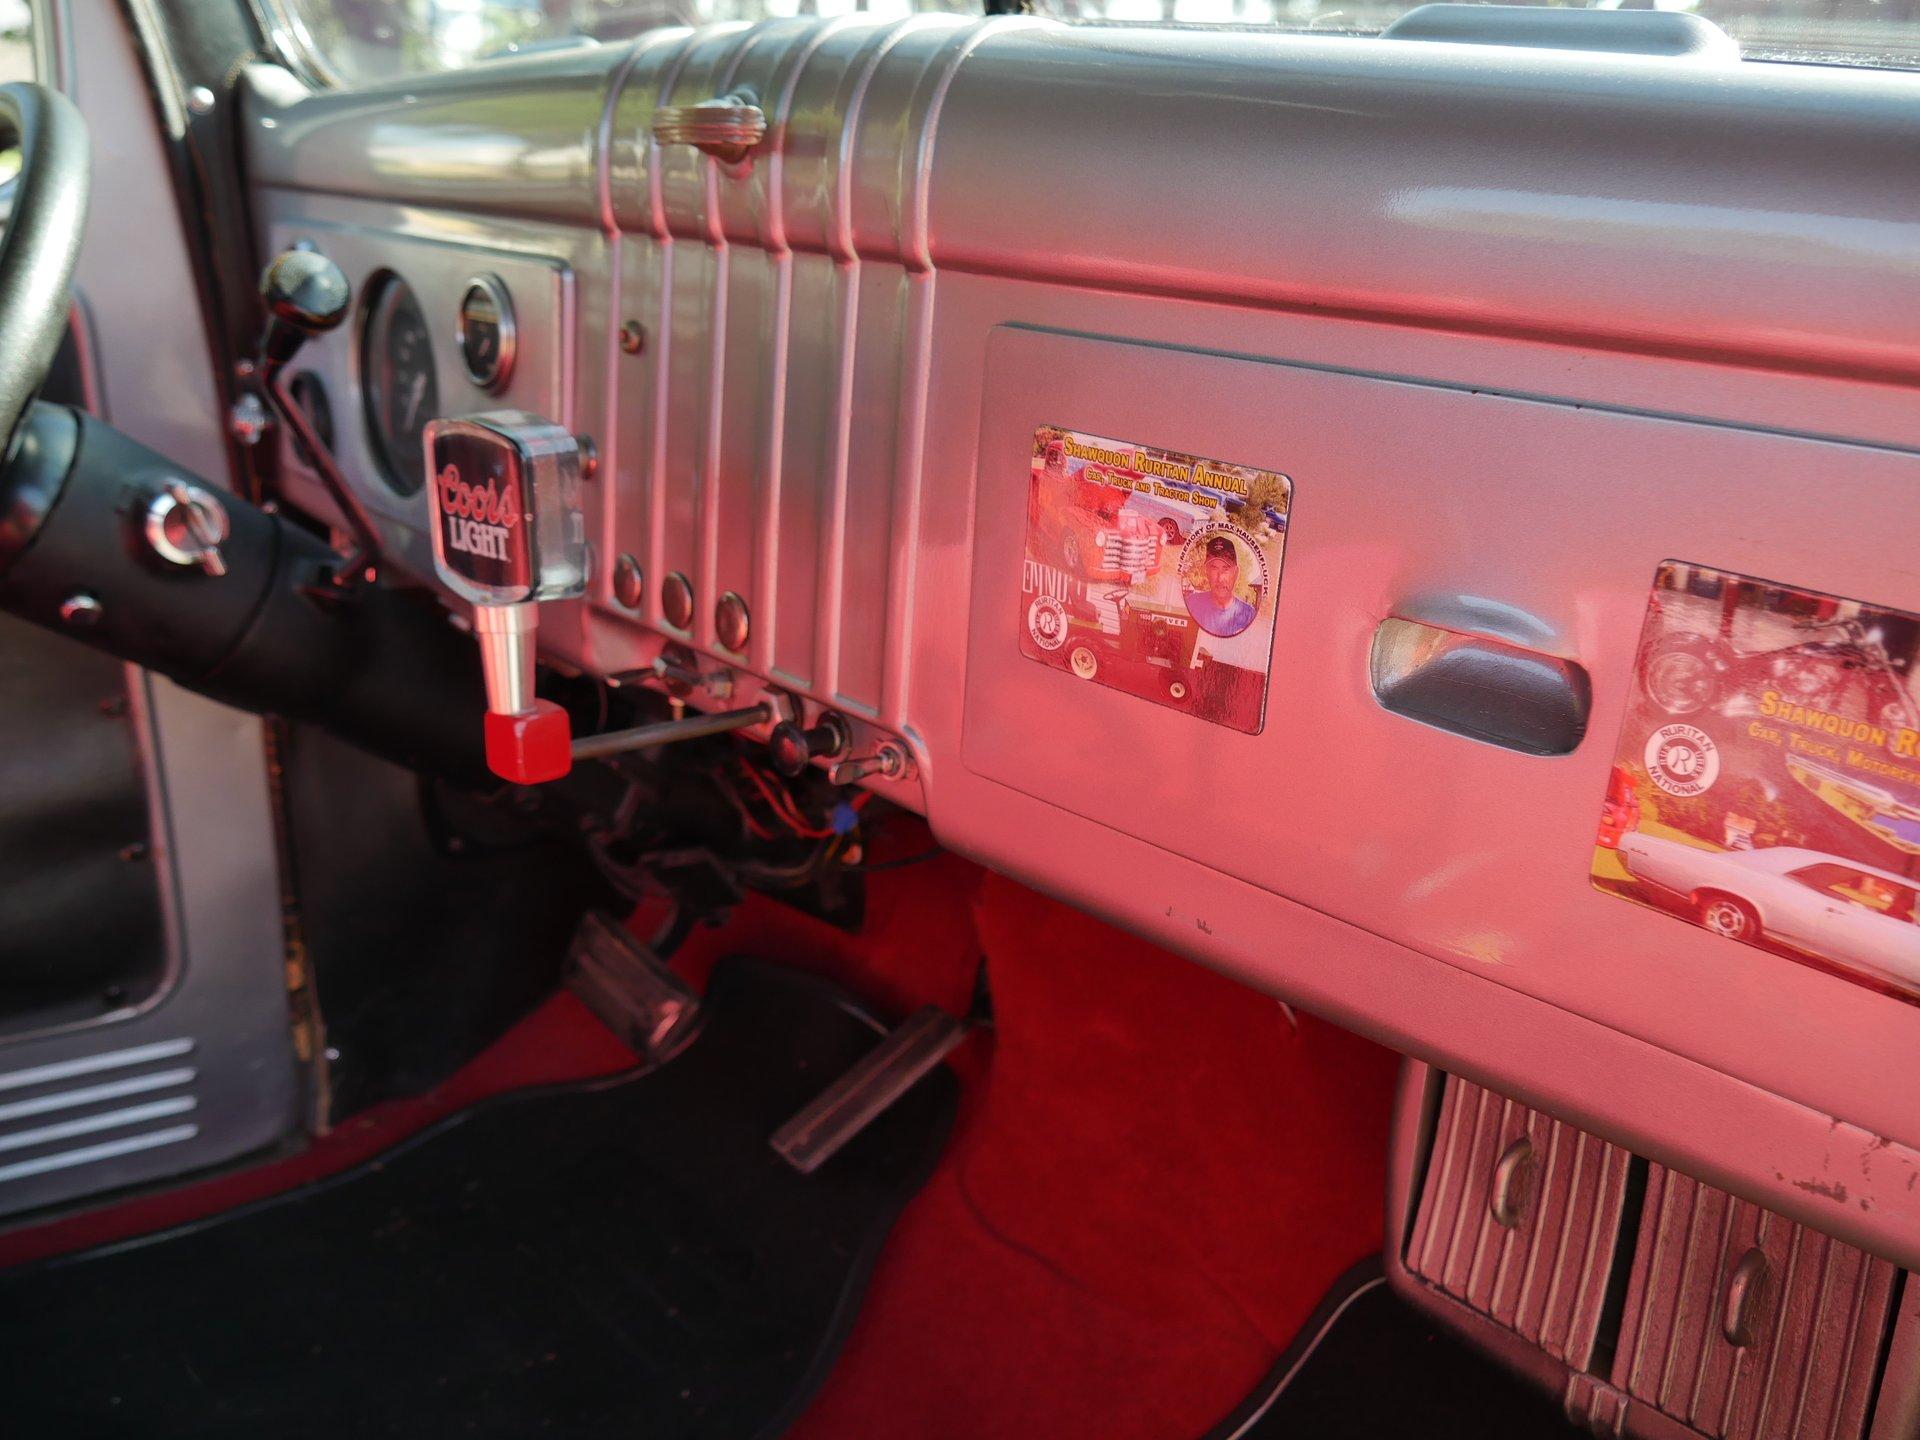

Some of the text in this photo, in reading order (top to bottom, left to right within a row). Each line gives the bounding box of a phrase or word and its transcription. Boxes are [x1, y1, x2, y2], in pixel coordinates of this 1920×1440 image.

[1064, 436, 1247, 495] SHAWQUON RURITAN ANNUAL
[437, 463, 519, 528] Coors
[1107, 471, 1133, 489] TRUCK
[1135, 481, 1151, 493] AND
[1153, 482, 1190, 503] TRACTOR
[1191, 490, 1218, 509] SHOW
[449, 515, 510, 562] LIGHT
[1180, 527, 1203, 561] MEMORY
[1218, 522, 1235, 531] MAX
[1660, 726, 1714, 752] RURITAN
[1760, 691, 1887, 746] SHAWQUON
[1649, 765, 1705, 794] NATIONAL
